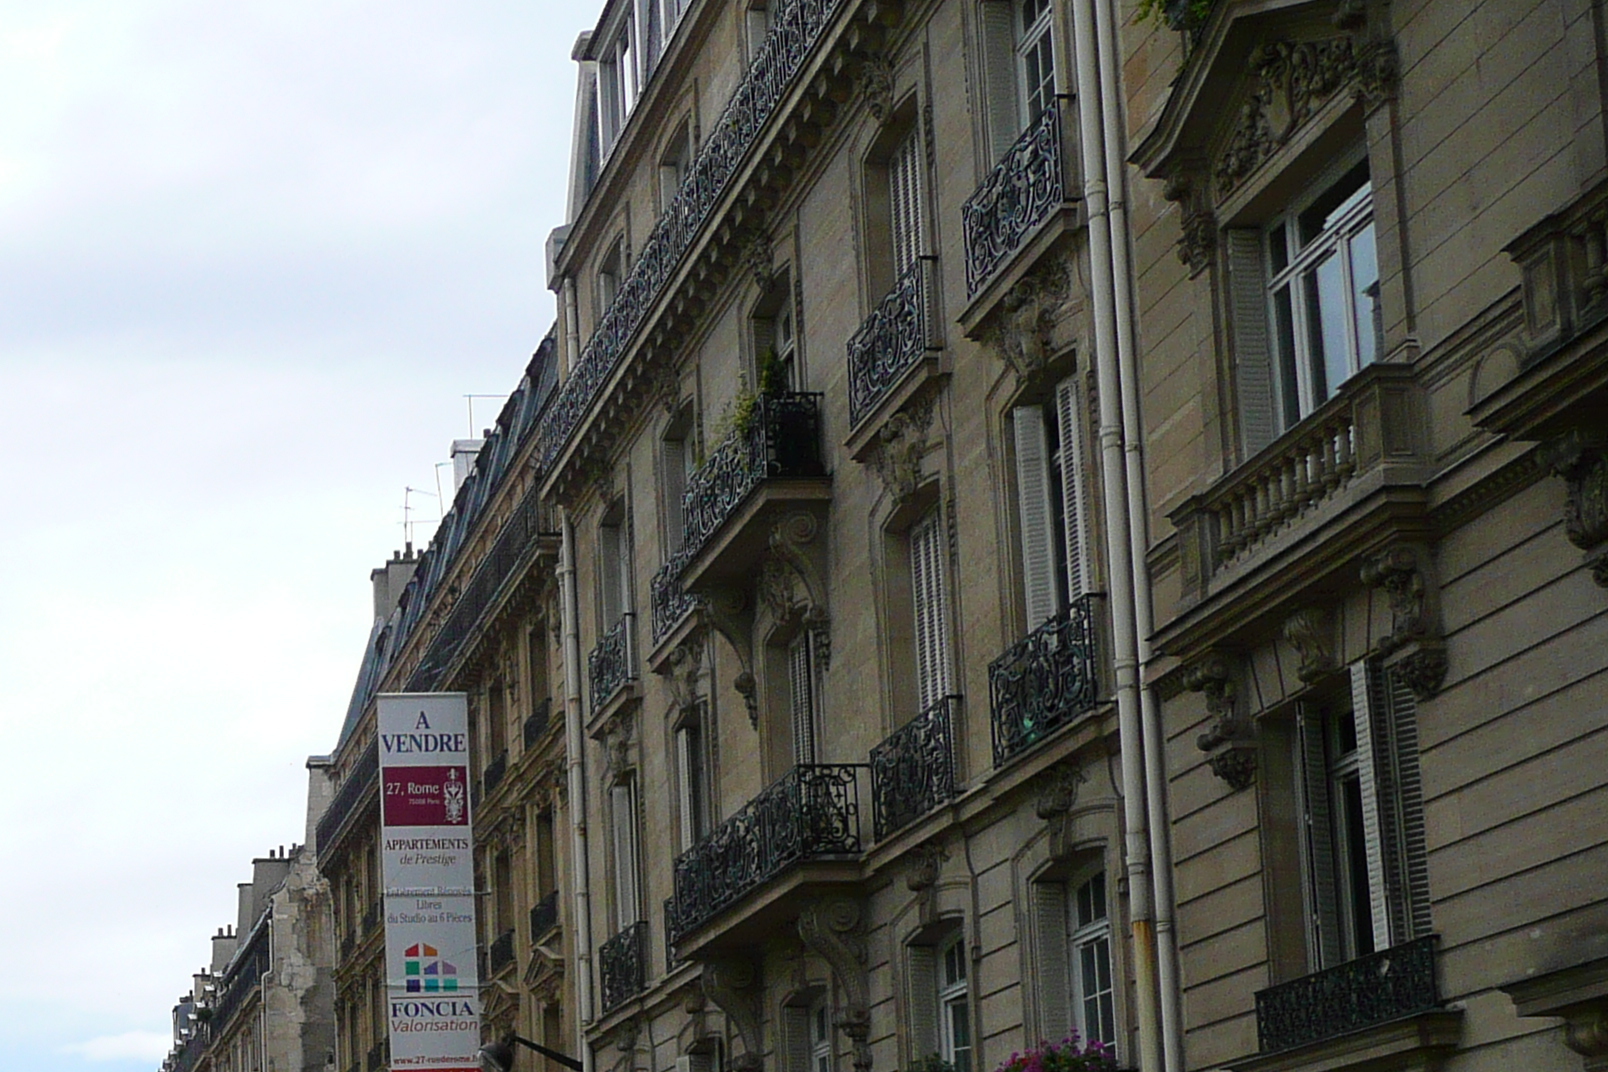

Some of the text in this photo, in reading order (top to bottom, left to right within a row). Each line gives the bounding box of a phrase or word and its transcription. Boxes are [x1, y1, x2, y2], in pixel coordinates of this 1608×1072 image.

[416, 711, 430, 729] A
[382, 734, 466, 753] VENDRE
[386, 782, 439, 796] 27, Rome
[385, 839, 468, 850] APPARTEMENTS
[400, 853, 456, 866] de Prestige
[417, 900, 442, 910] Libres
[387, 912, 472, 923] du Studio au 6 Pièces
[392, 1001, 474, 1017] FONCIA
[391, 1020, 478, 1032] Valorisation
